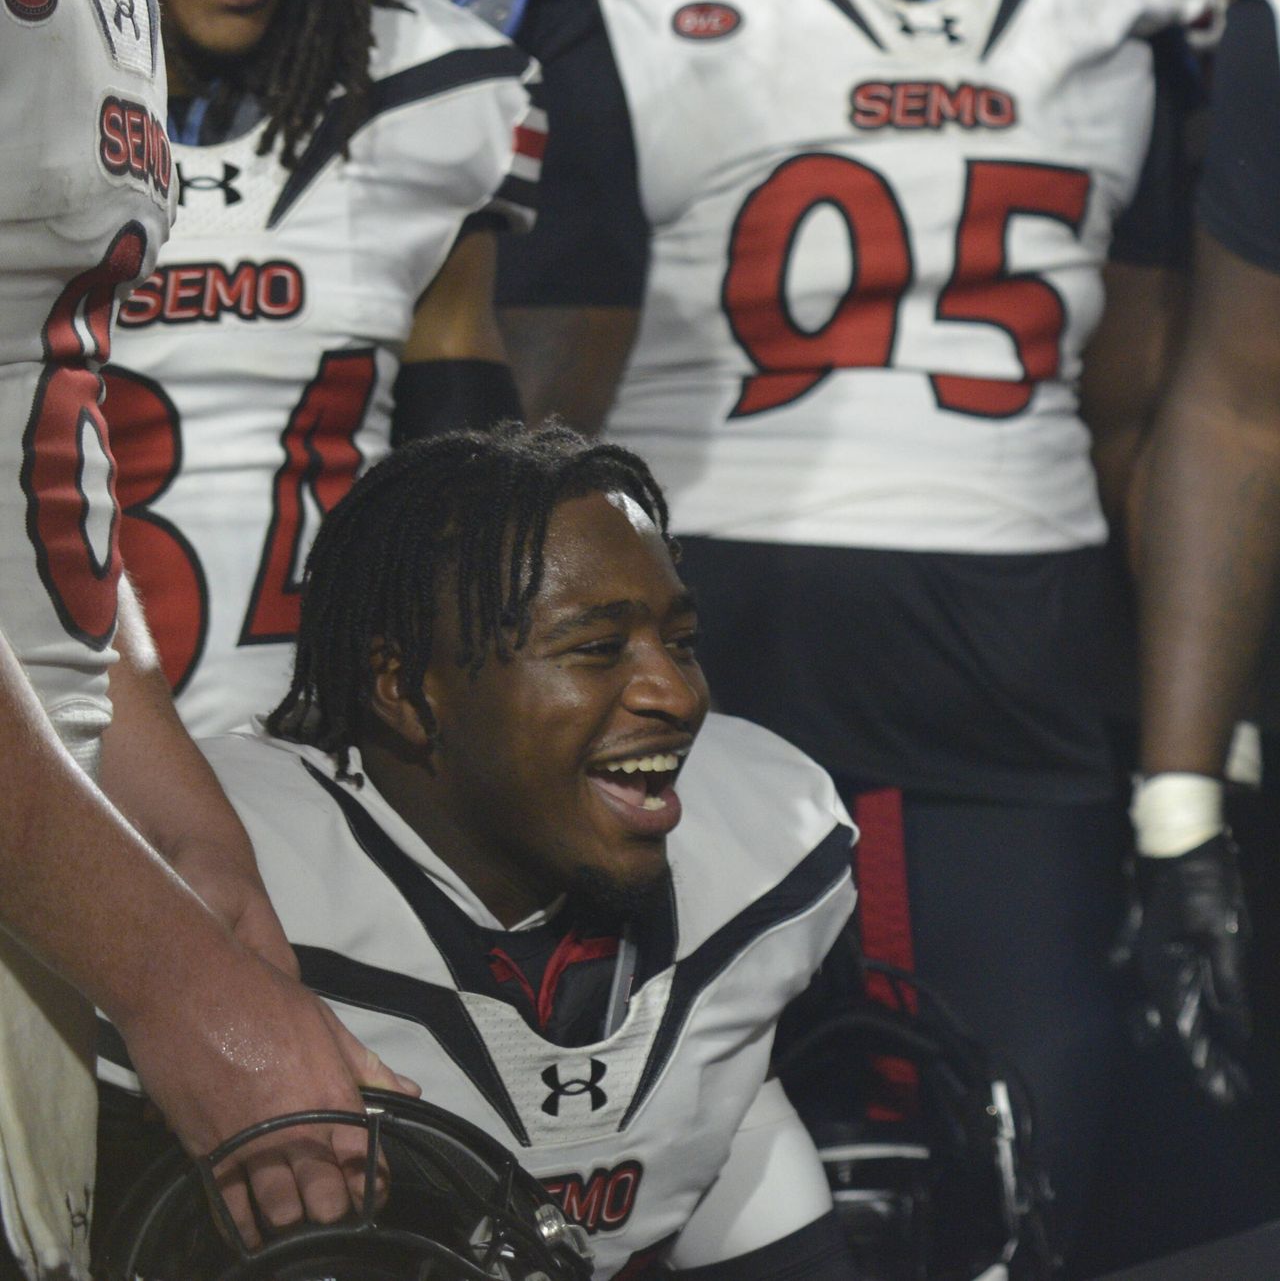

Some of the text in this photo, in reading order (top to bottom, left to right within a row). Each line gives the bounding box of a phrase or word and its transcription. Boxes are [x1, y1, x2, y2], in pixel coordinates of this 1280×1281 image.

[101, 95, 171, 198] SEMO
[850, 80, 1017, 130] SEMO
[119, 260, 305, 329] SEMO
[722, 150, 1092, 422] 95
